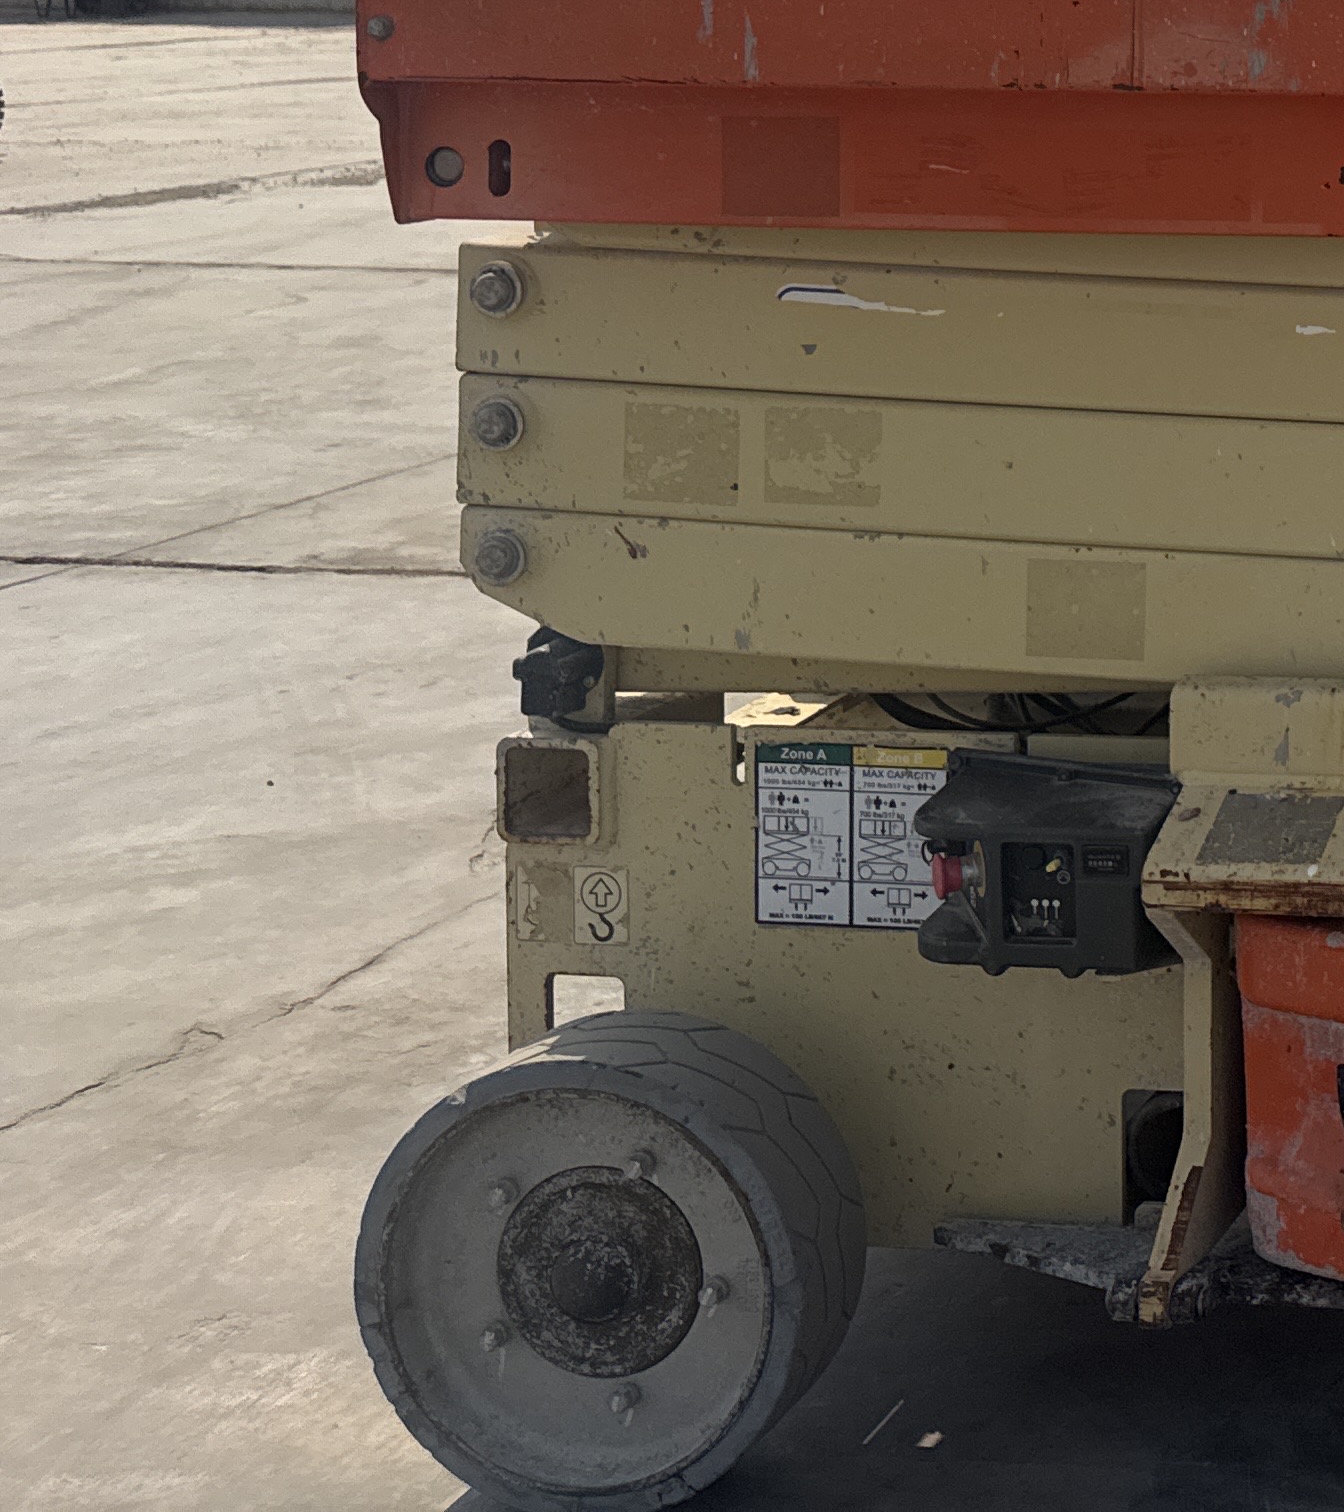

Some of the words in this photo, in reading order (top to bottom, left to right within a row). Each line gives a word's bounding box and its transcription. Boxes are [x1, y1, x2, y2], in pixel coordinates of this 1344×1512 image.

[781, 747, 814, 760] Zone
[816, 750, 828, 761] A
[877, 751, 910, 764] Zone
[764, 765, 787, 775] MAX
[790, 766, 841, 777] CAPACITY
[862, 769, 885, 778] MAX
[887, 770, 937, 780] CAPACITY
